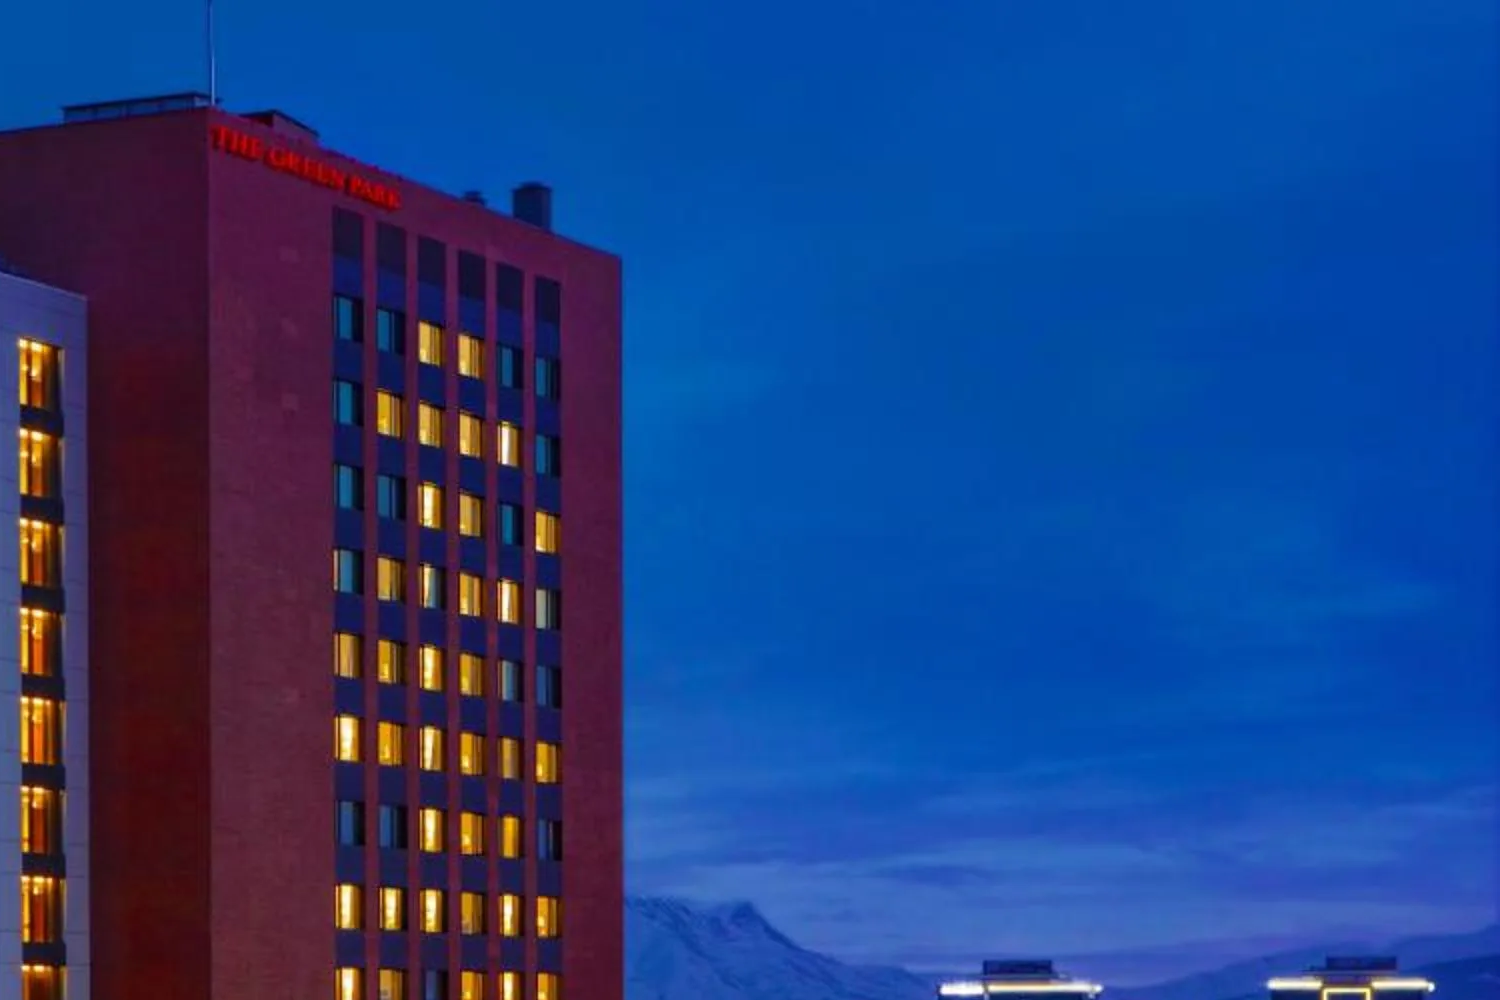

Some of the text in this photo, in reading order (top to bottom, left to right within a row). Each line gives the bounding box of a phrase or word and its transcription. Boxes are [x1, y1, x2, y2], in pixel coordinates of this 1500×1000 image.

[211, 124, 402, 210] THE GREEN PARK
